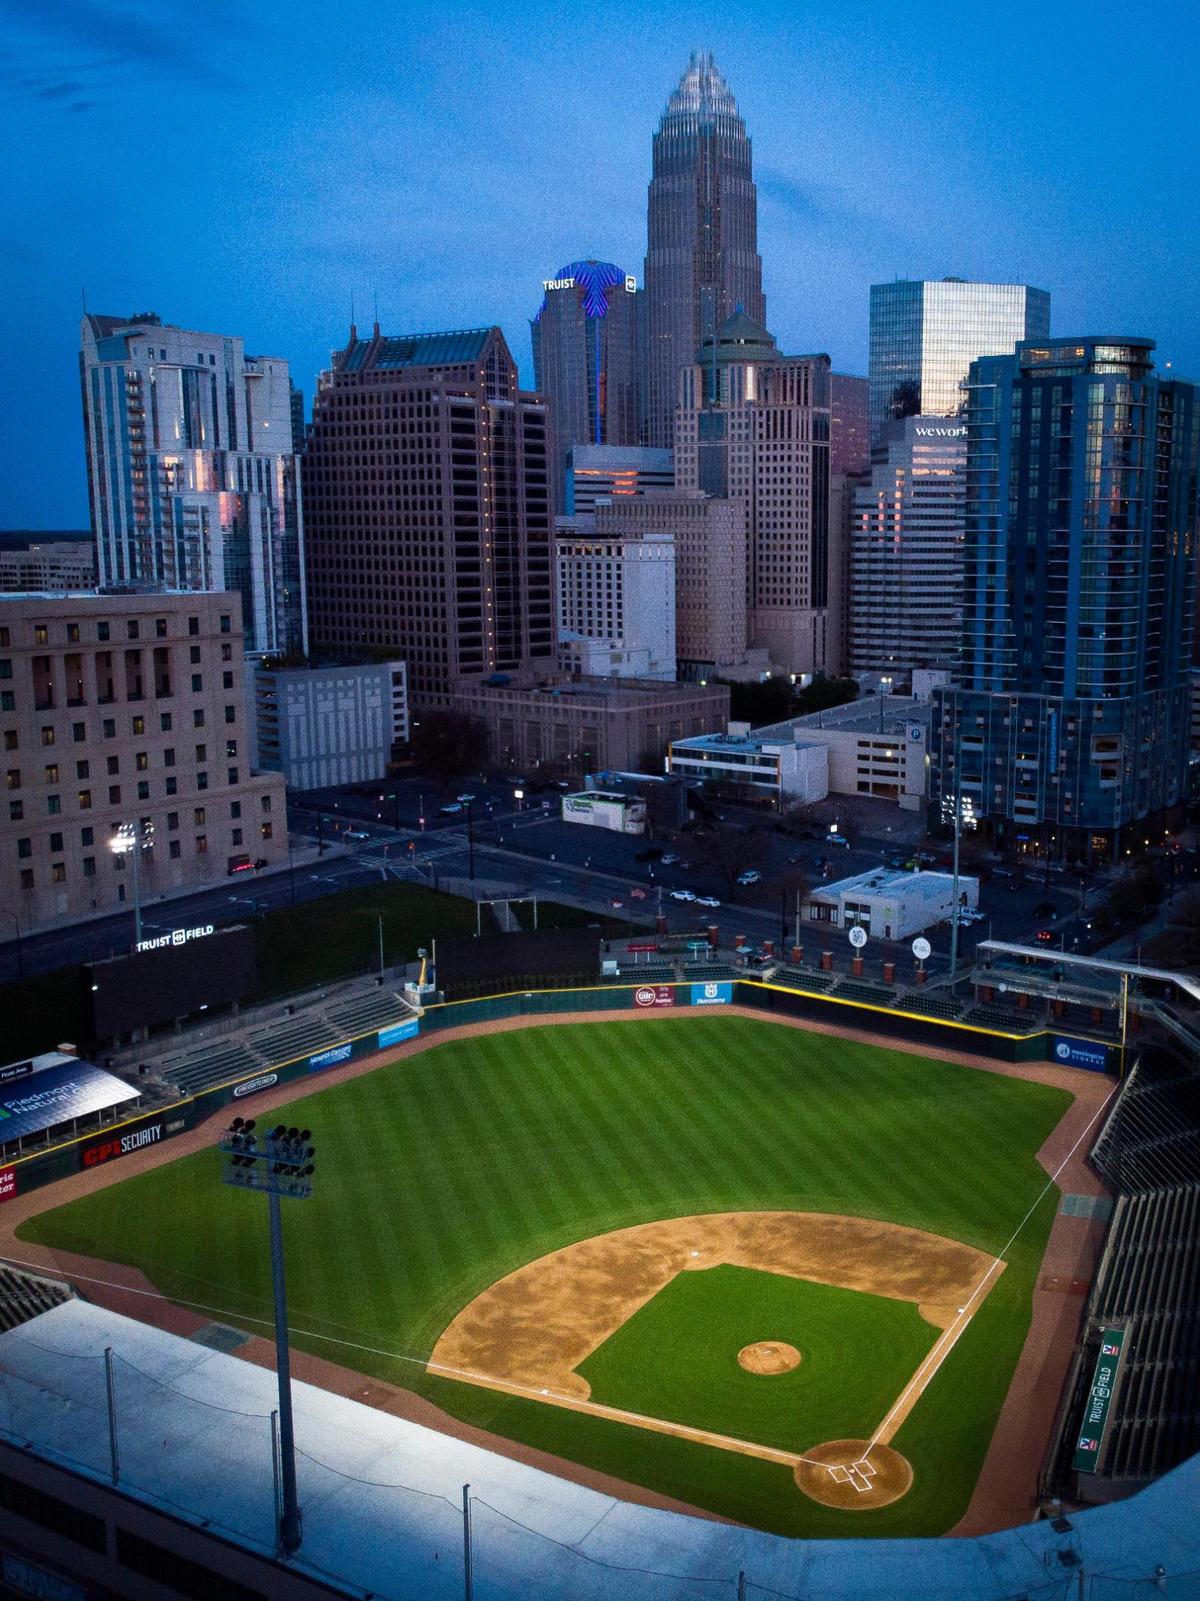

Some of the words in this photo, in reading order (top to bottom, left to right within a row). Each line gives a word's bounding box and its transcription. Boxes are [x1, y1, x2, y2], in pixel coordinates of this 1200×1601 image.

[543, 278, 575, 291] TRUIST
[136, 935, 171, 953] TRUIST
[186, 925, 214, 940] FIELD
[4, 1081, 79, 1109] Piedmont
[13, 1092, 71, 1114] Natural
[121, 1125, 160, 1152] SECURITY
[1089, 1397, 1105, 1423] TRUIST
[1098, 1367, 1111, 1388] FIELD
